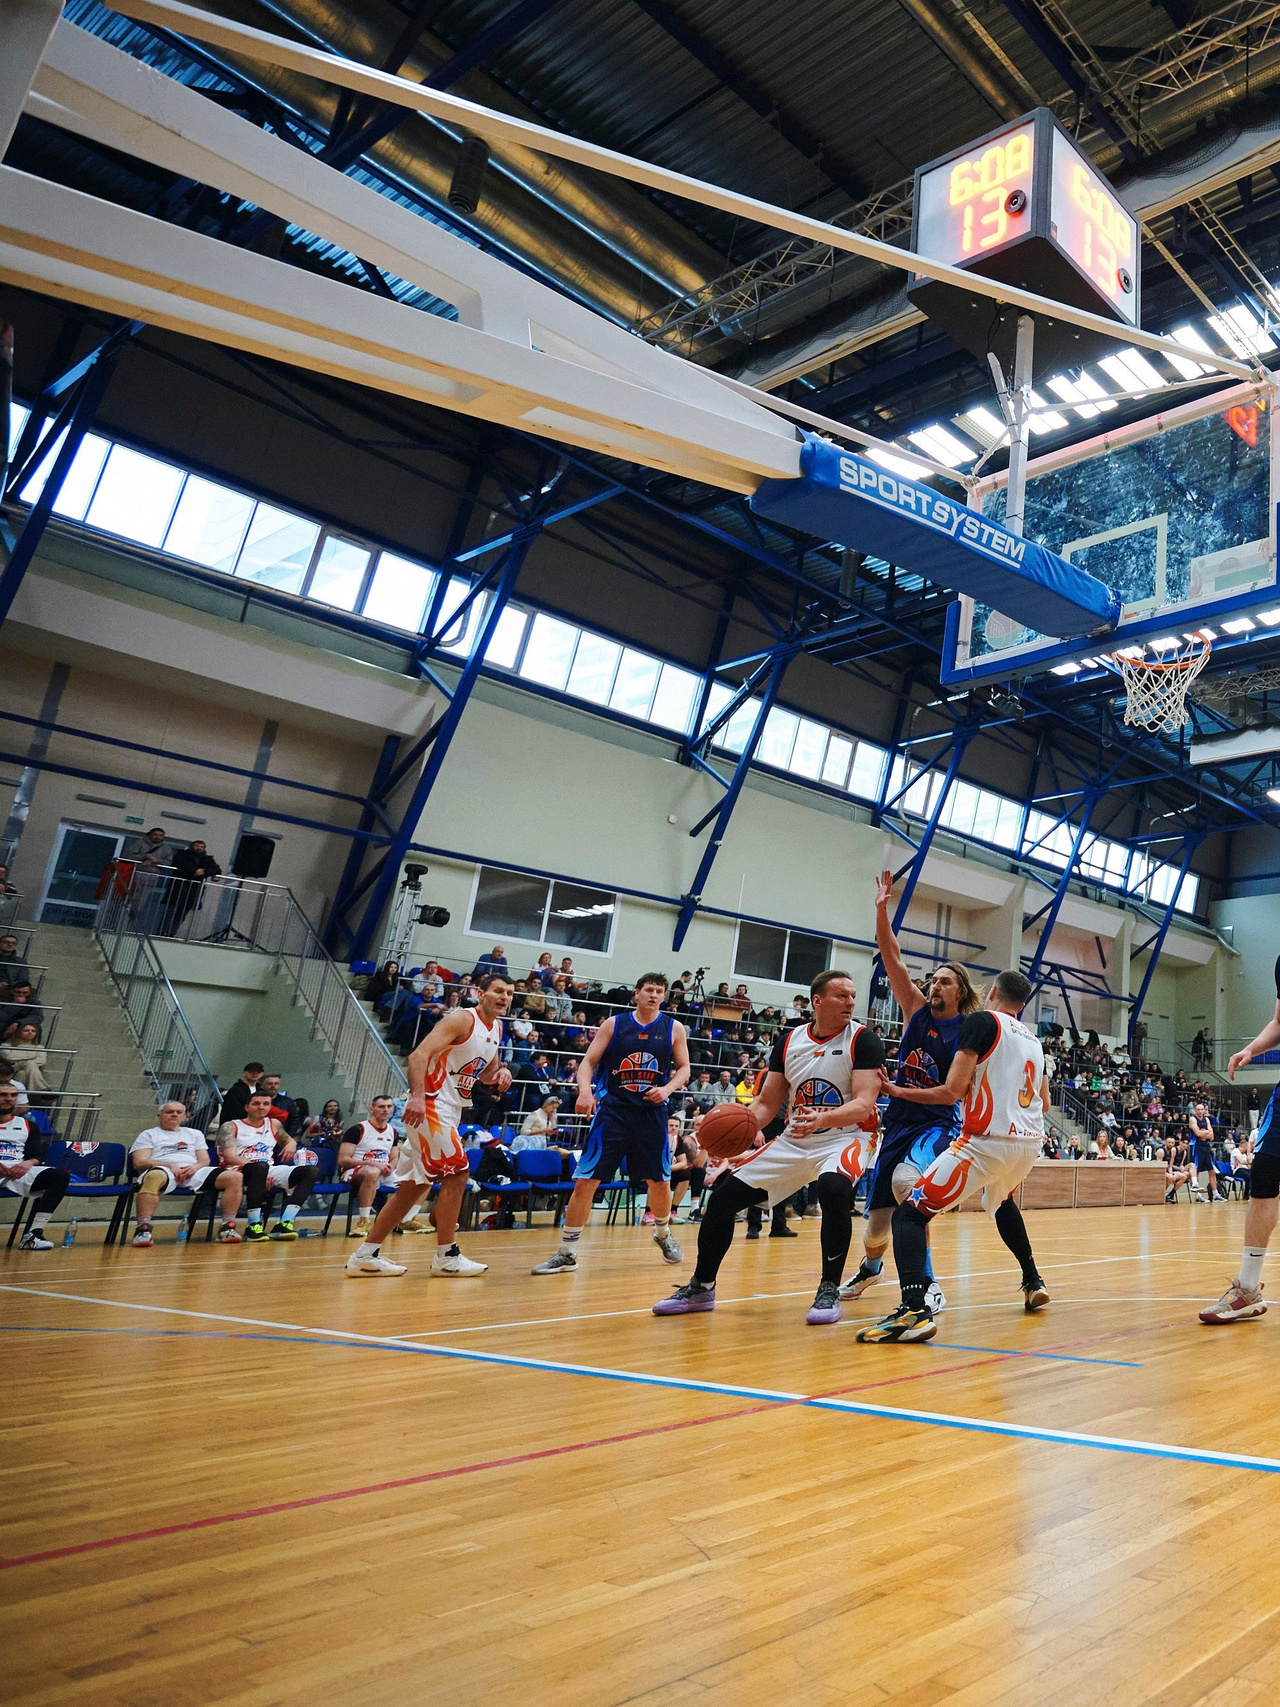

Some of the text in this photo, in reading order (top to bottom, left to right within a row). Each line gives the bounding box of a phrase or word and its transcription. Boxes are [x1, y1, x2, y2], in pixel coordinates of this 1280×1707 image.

[950, 133, 1030, 206] 6:08
[962, 187, 1010, 252] 13
[1072, 164, 1131, 259] 6:08
[1083, 221, 1117, 295] 13
